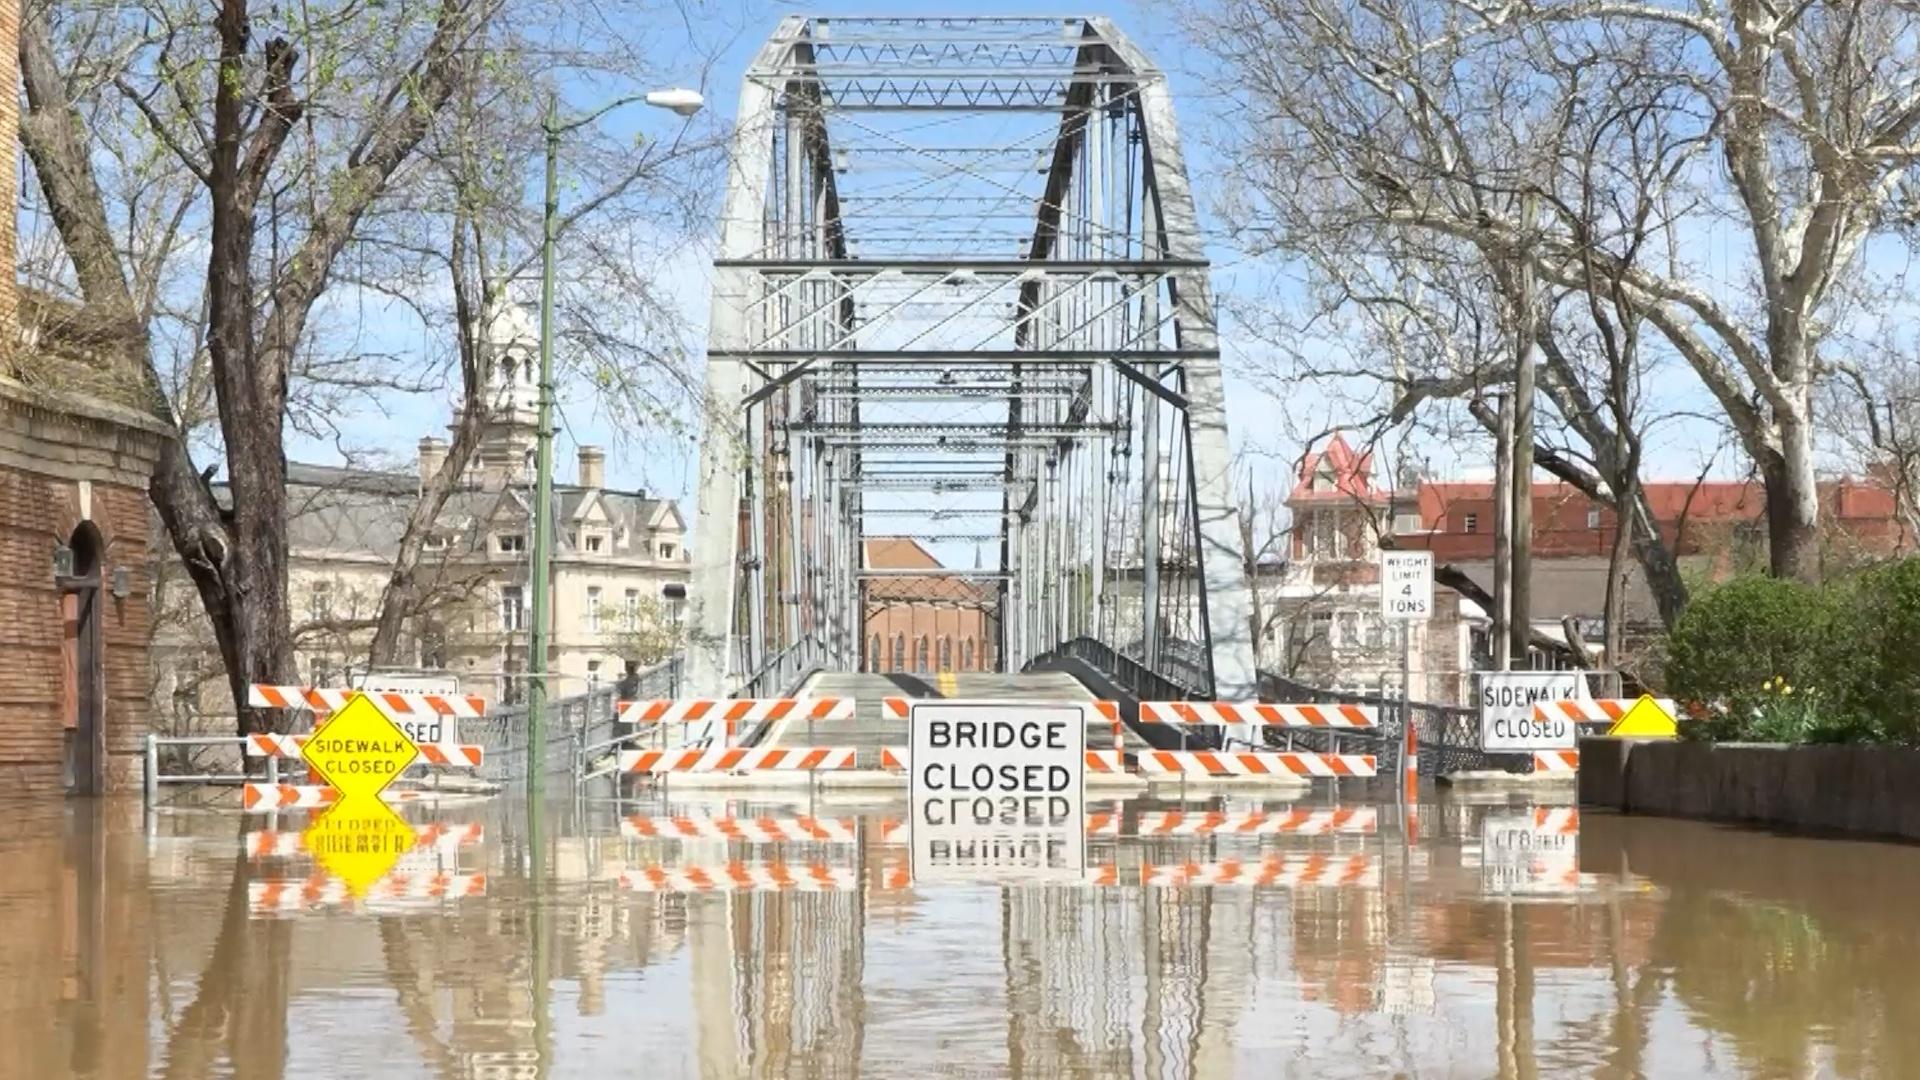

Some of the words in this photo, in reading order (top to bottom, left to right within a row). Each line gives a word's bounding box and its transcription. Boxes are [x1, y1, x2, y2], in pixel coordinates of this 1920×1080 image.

[1392, 571, 1421, 581] LIMIT
[1401, 584, 1412, 597] 4
[1389, 600, 1426, 613] TONS
[1495, 718, 1565, 738] CLOSED
[930, 722, 1067, 749] BRIDGE
[315, 740, 405, 753] SIDEWALK
[325, 760, 396, 774] CLOSED
[924, 763, 1070, 791] CLOSED
